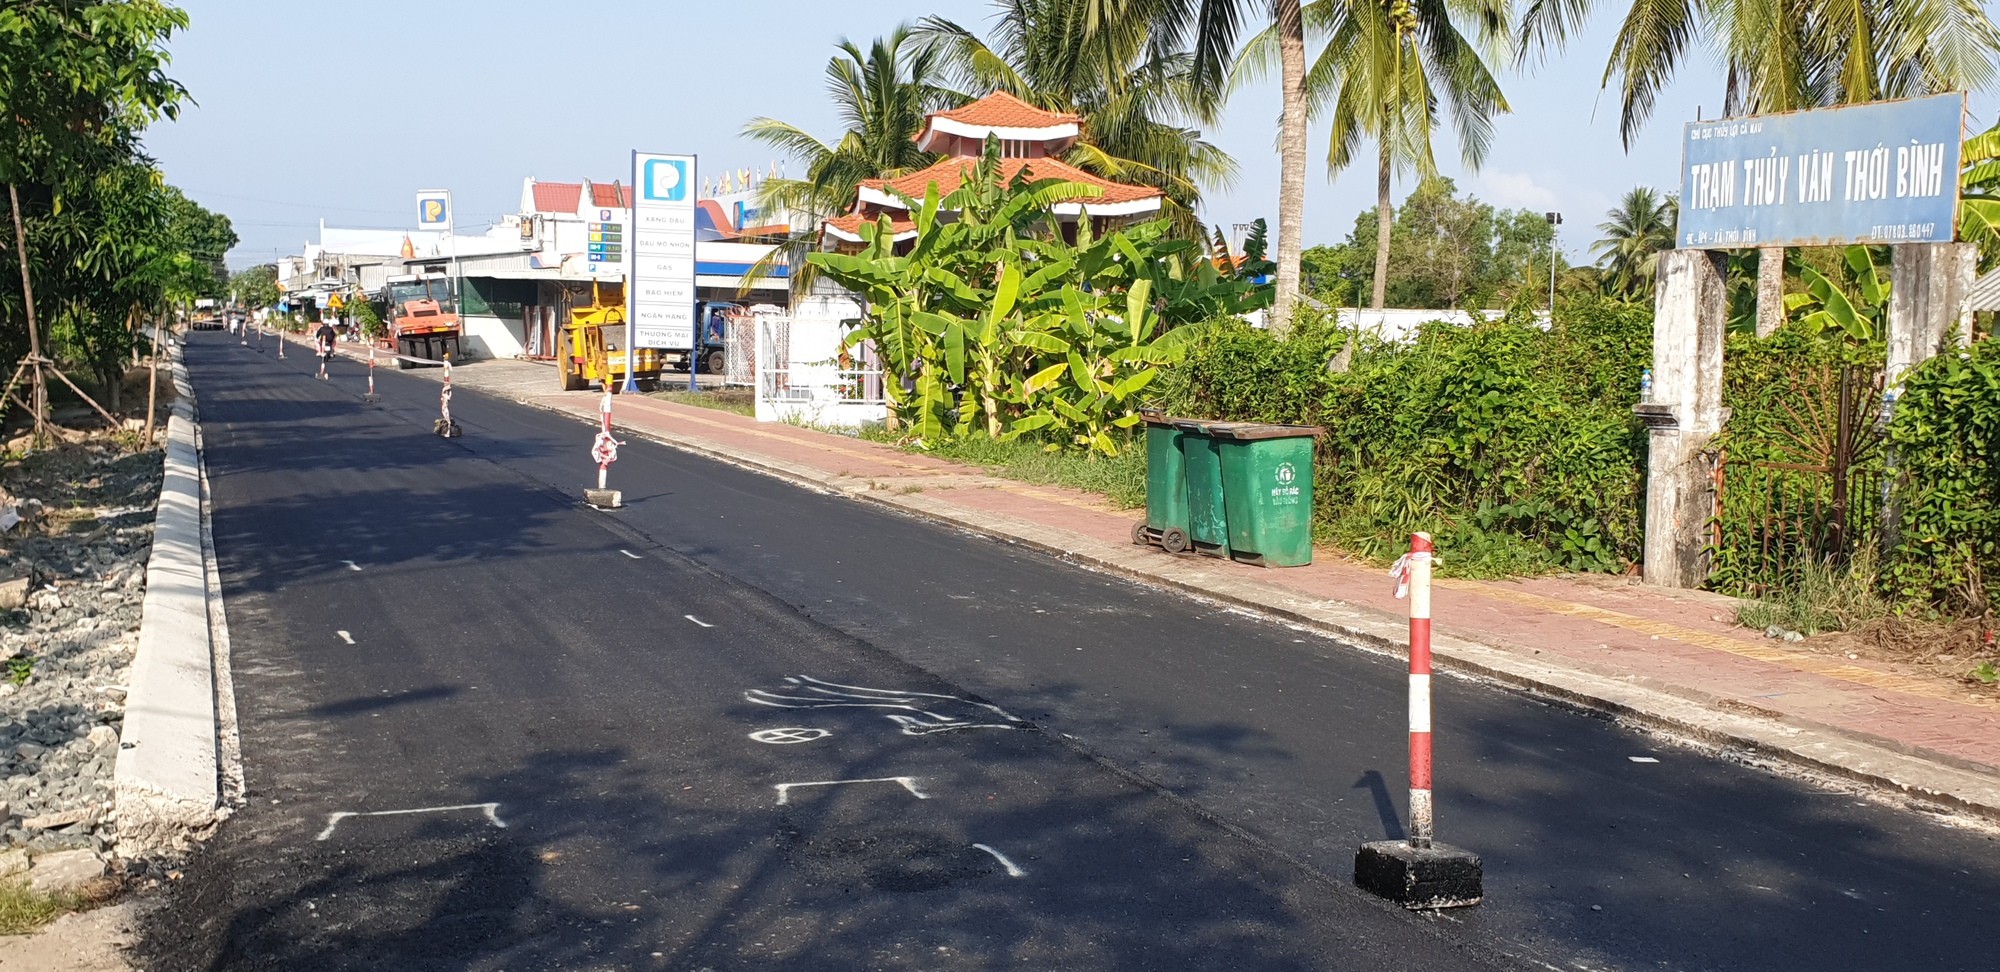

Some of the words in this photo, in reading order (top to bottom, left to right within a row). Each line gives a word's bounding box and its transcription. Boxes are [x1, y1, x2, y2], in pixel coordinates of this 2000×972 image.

[1691, 159, 1735, 213] TRẠM
[1743, 146, 1789, 206] THỦY
[1798, 149, 1834, 204] VĂN
[1845, 141, 1890, 202] THỚI
[1896, 138, 1945, 198] BÌNH
